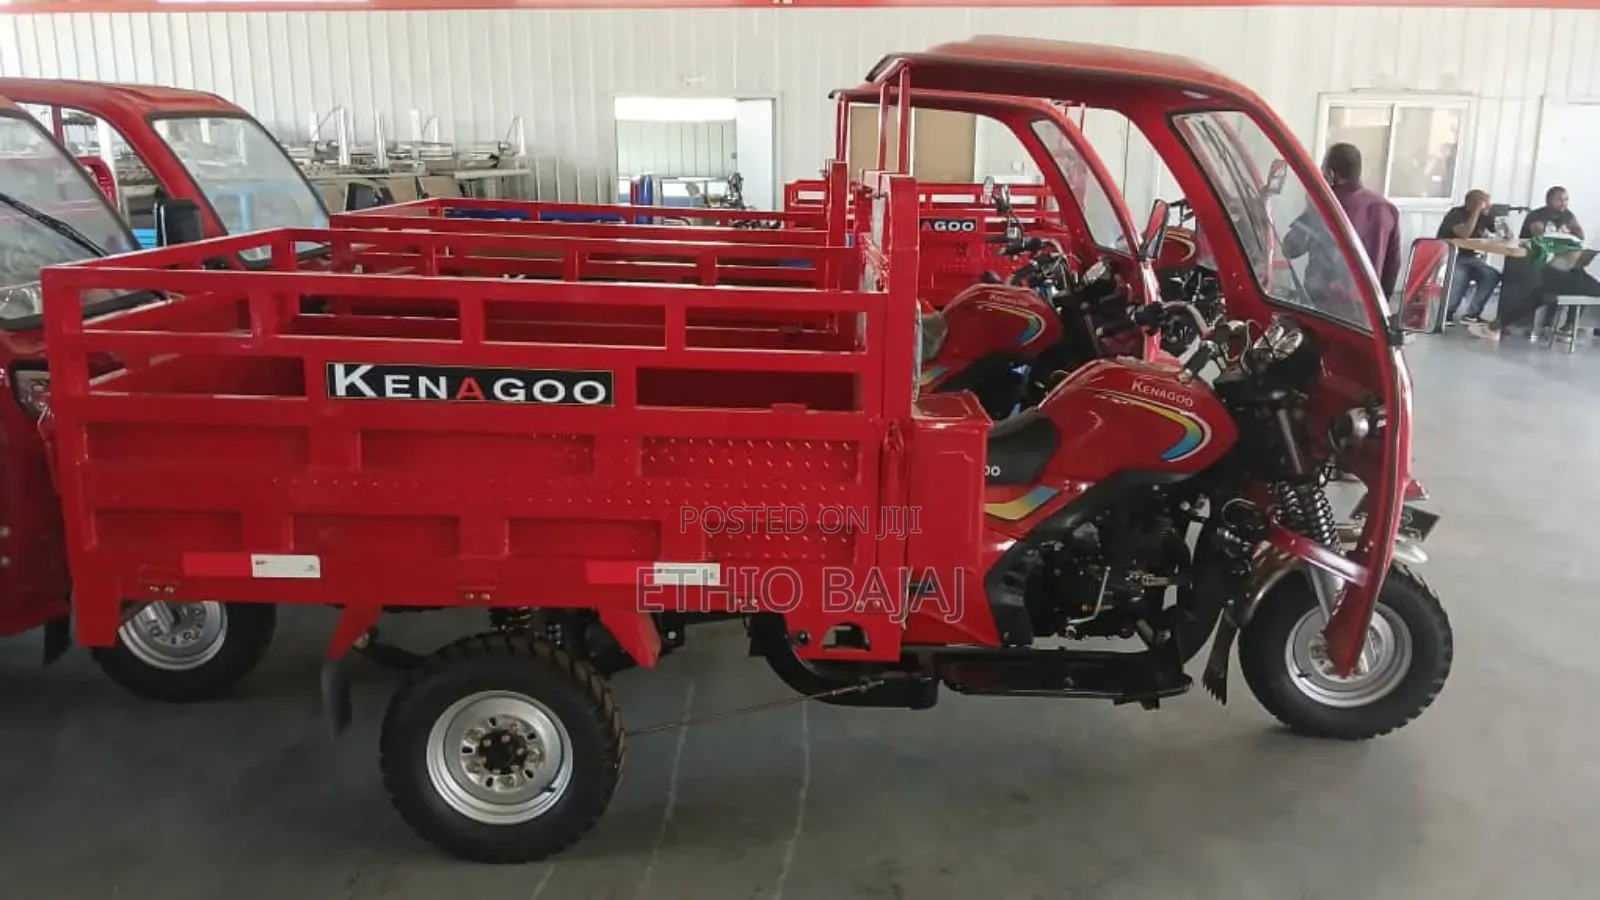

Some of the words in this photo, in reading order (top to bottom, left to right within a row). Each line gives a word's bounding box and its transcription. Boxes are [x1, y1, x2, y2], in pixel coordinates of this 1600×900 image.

[921, 220, 974, 232] AGOO
[333, 363, 606, 404] KENAGOO
[1131, 380, 1194, 408] KENAGOO
[984, 465, 1001, 477] OO
